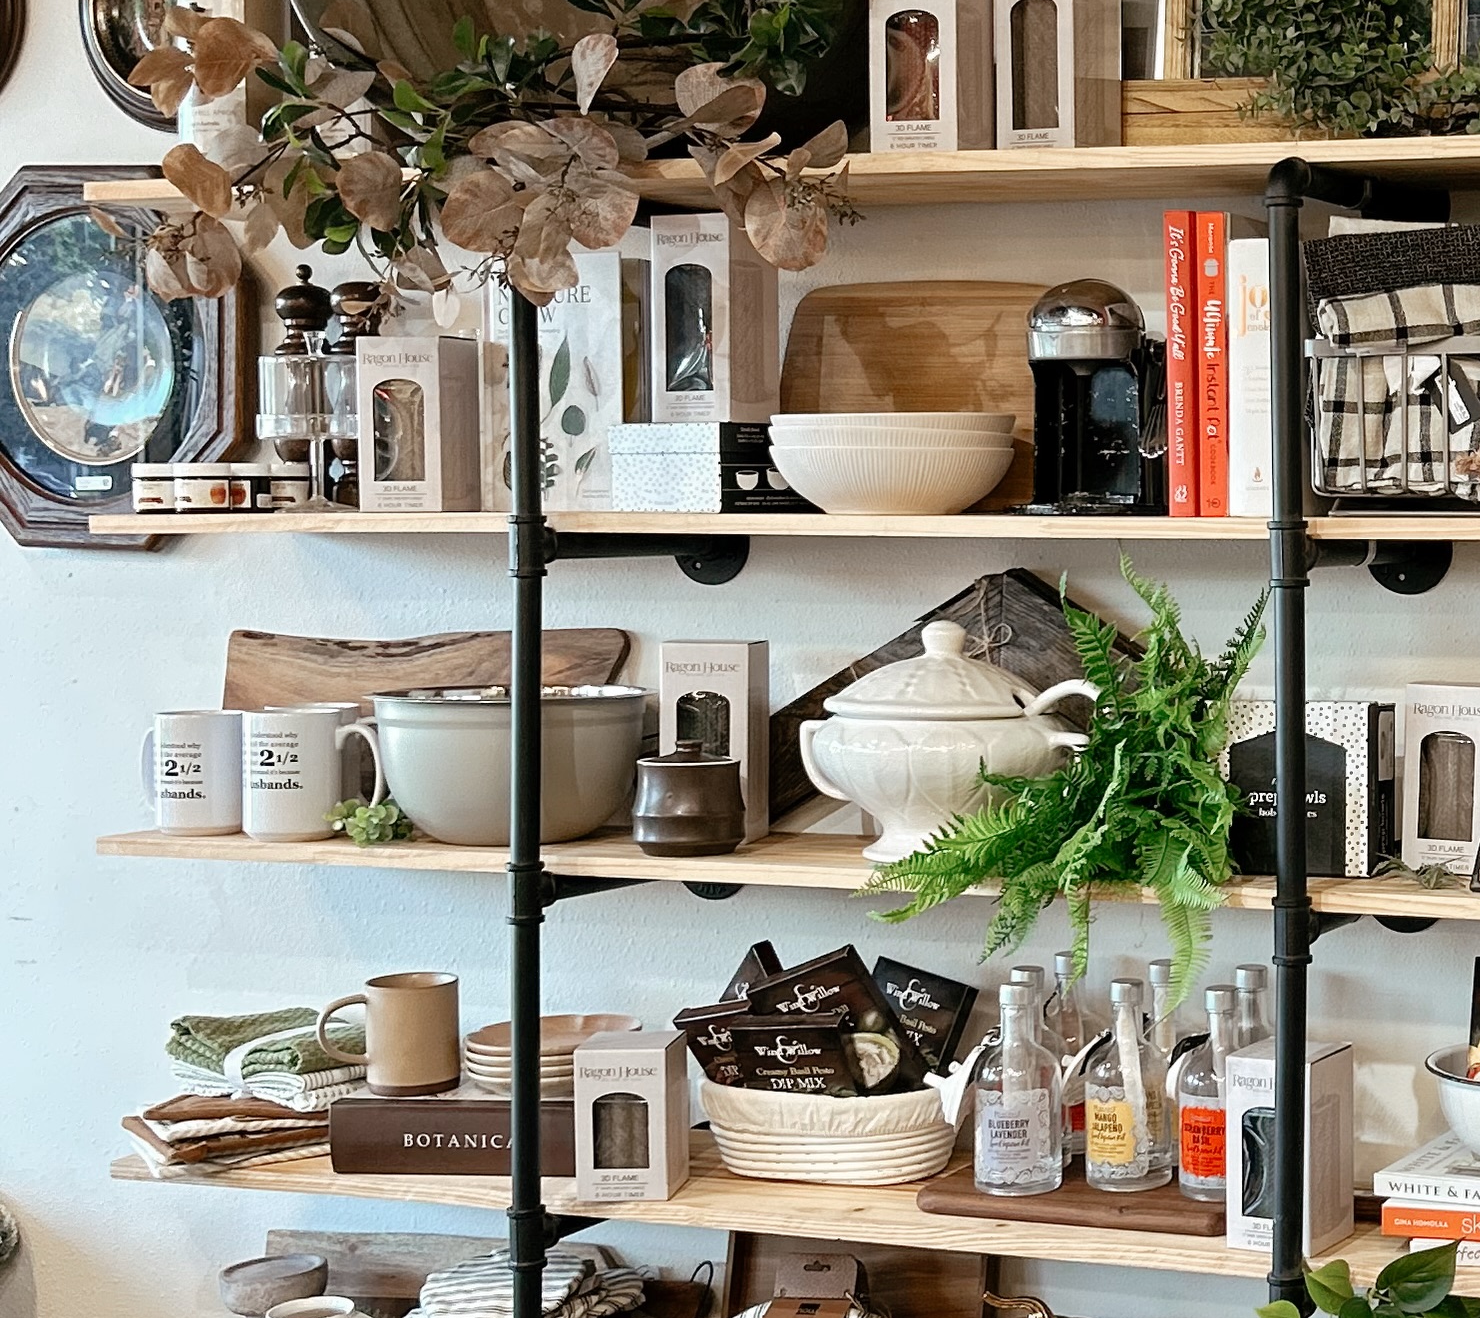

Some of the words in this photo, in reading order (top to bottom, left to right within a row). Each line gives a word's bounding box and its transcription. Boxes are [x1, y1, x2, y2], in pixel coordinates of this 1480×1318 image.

[1206, 363, 1220, 412] Instant
[1174, 382, 1184, 424] BRENDA
[1175, 428, 1185, 465] GANTT
[259, 749, 275, 767] 2
[164, 759, 179, 777] 2
[180, 762, 202, 776] 1/2
[756, 1066, 788, 1078] Creamy
[790, 1065, 812, 1077] Basil
[813, 1065, 835, 1077] Pesto
[770, 1077, 796, 1090] DIP
[798, 1076, 827, 1090] MIX
[987, 1118, 1030, 1131] BLUEBERRY
[1094, 1112, 1118, 1124] MANGO
[990, 1128, 1028, 1139] LAVENDER
[1388, 1180, 1442, 1198] WHITE
[1447, 1186, 1460, 1200] &
